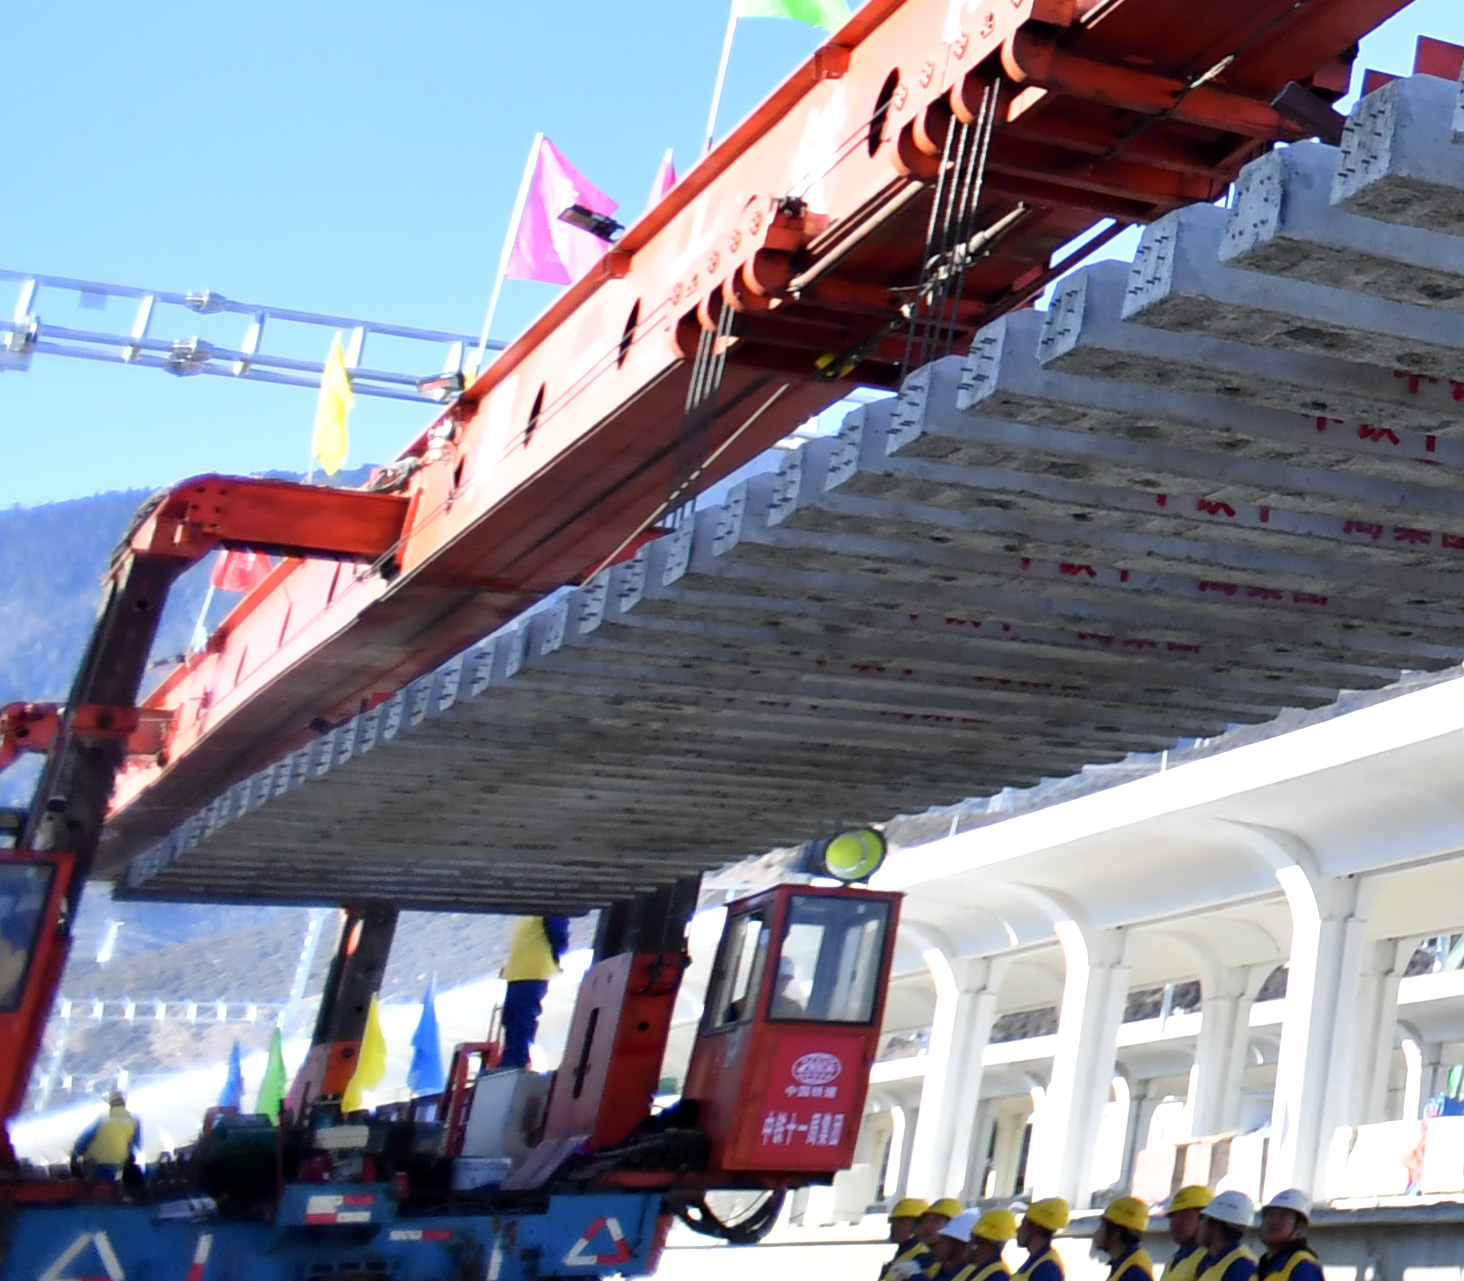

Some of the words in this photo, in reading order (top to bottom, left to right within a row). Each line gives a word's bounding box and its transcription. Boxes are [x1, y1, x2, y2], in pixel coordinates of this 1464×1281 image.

[762, 1111, 845, 1145] 中铁十一局集团
